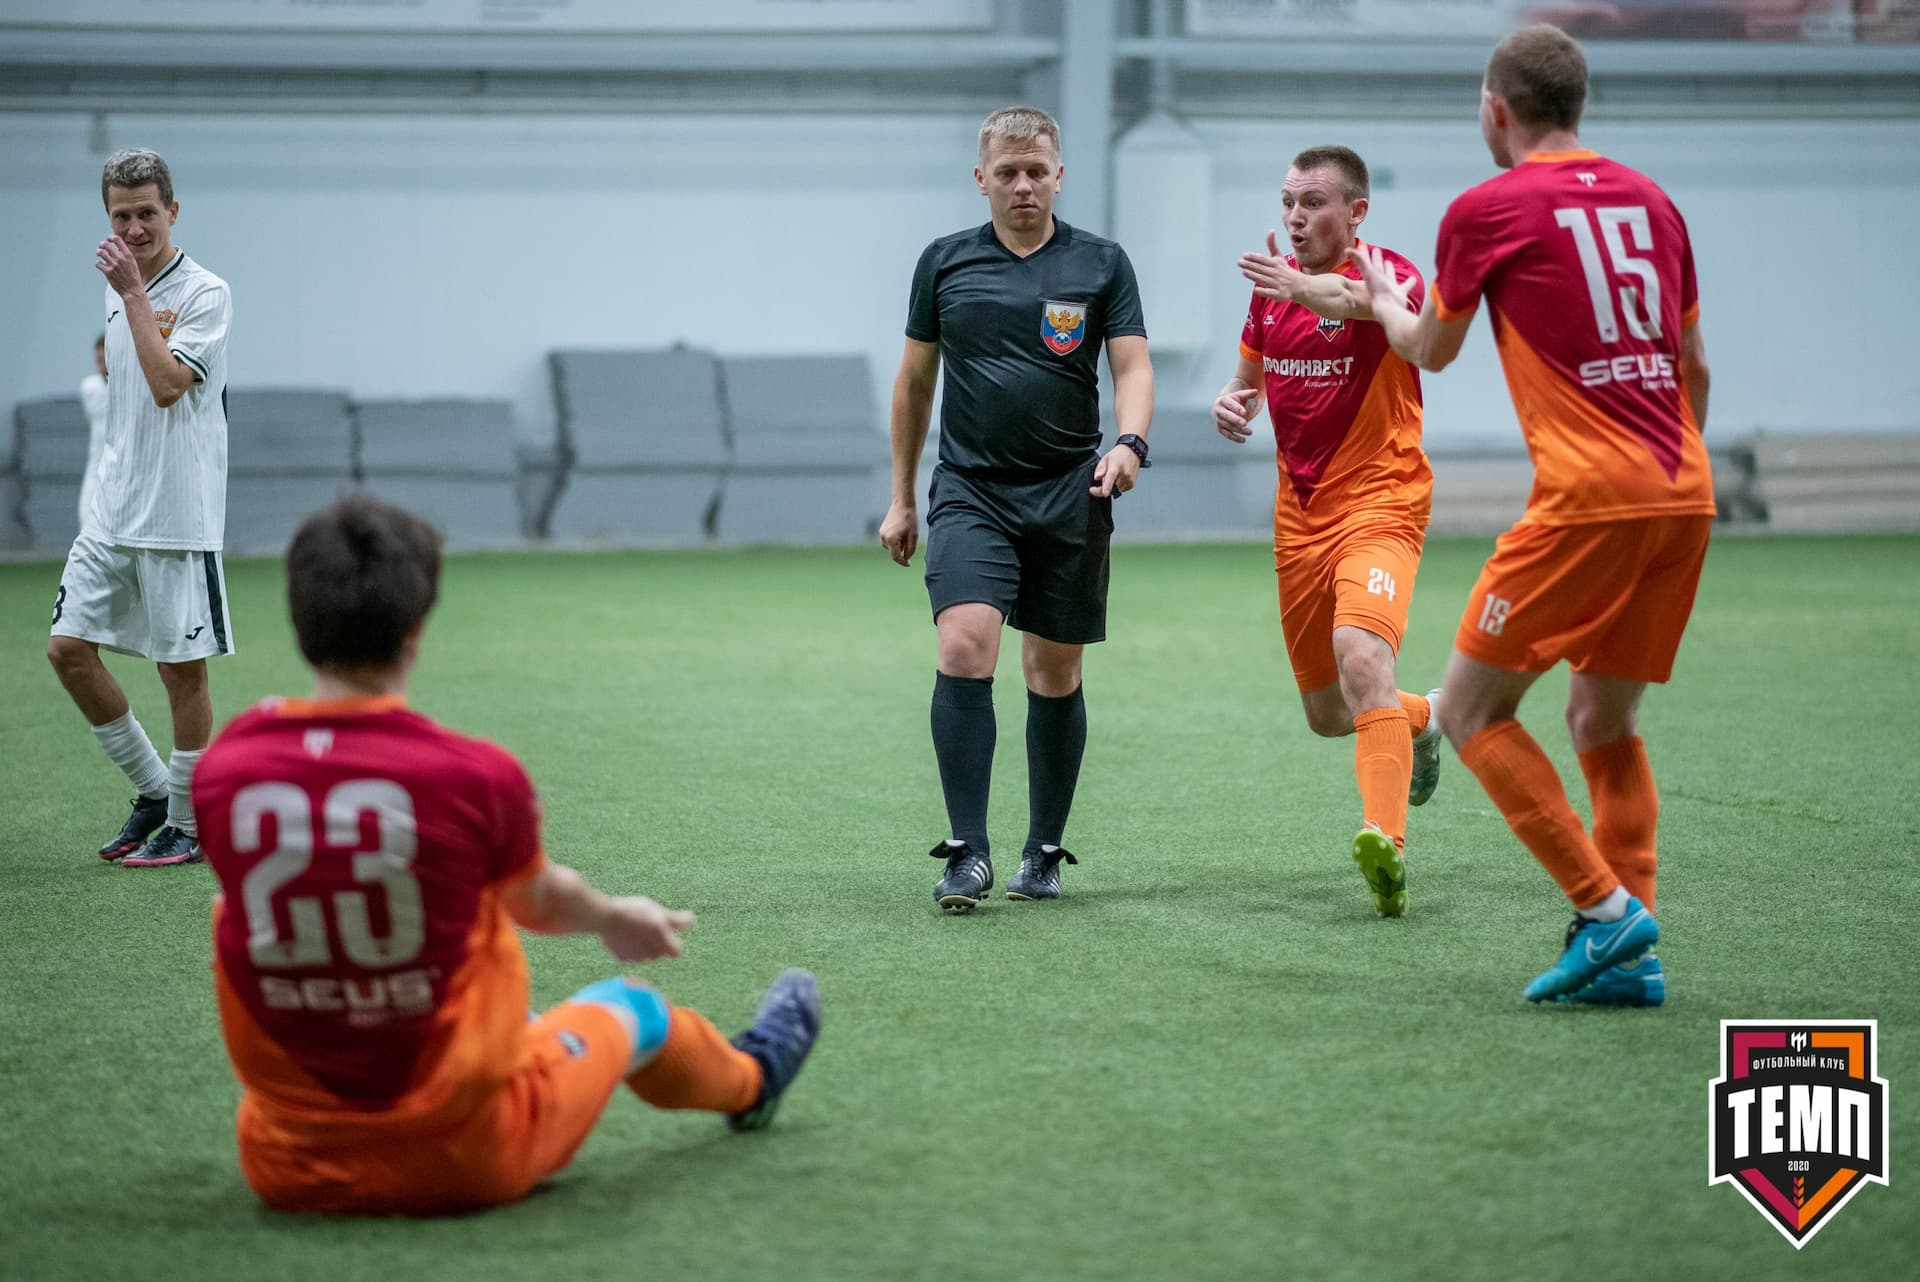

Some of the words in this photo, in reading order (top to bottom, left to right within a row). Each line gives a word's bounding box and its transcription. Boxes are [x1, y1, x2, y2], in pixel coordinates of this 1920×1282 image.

[1553, 205, 1662, 344] 15
[1579, 353, 1675, 387] SEUS
[1367, 567, 1396, 602] 24
[229, 778, 426, 968] 23
[259, 969, 434, 1015] SEUS
